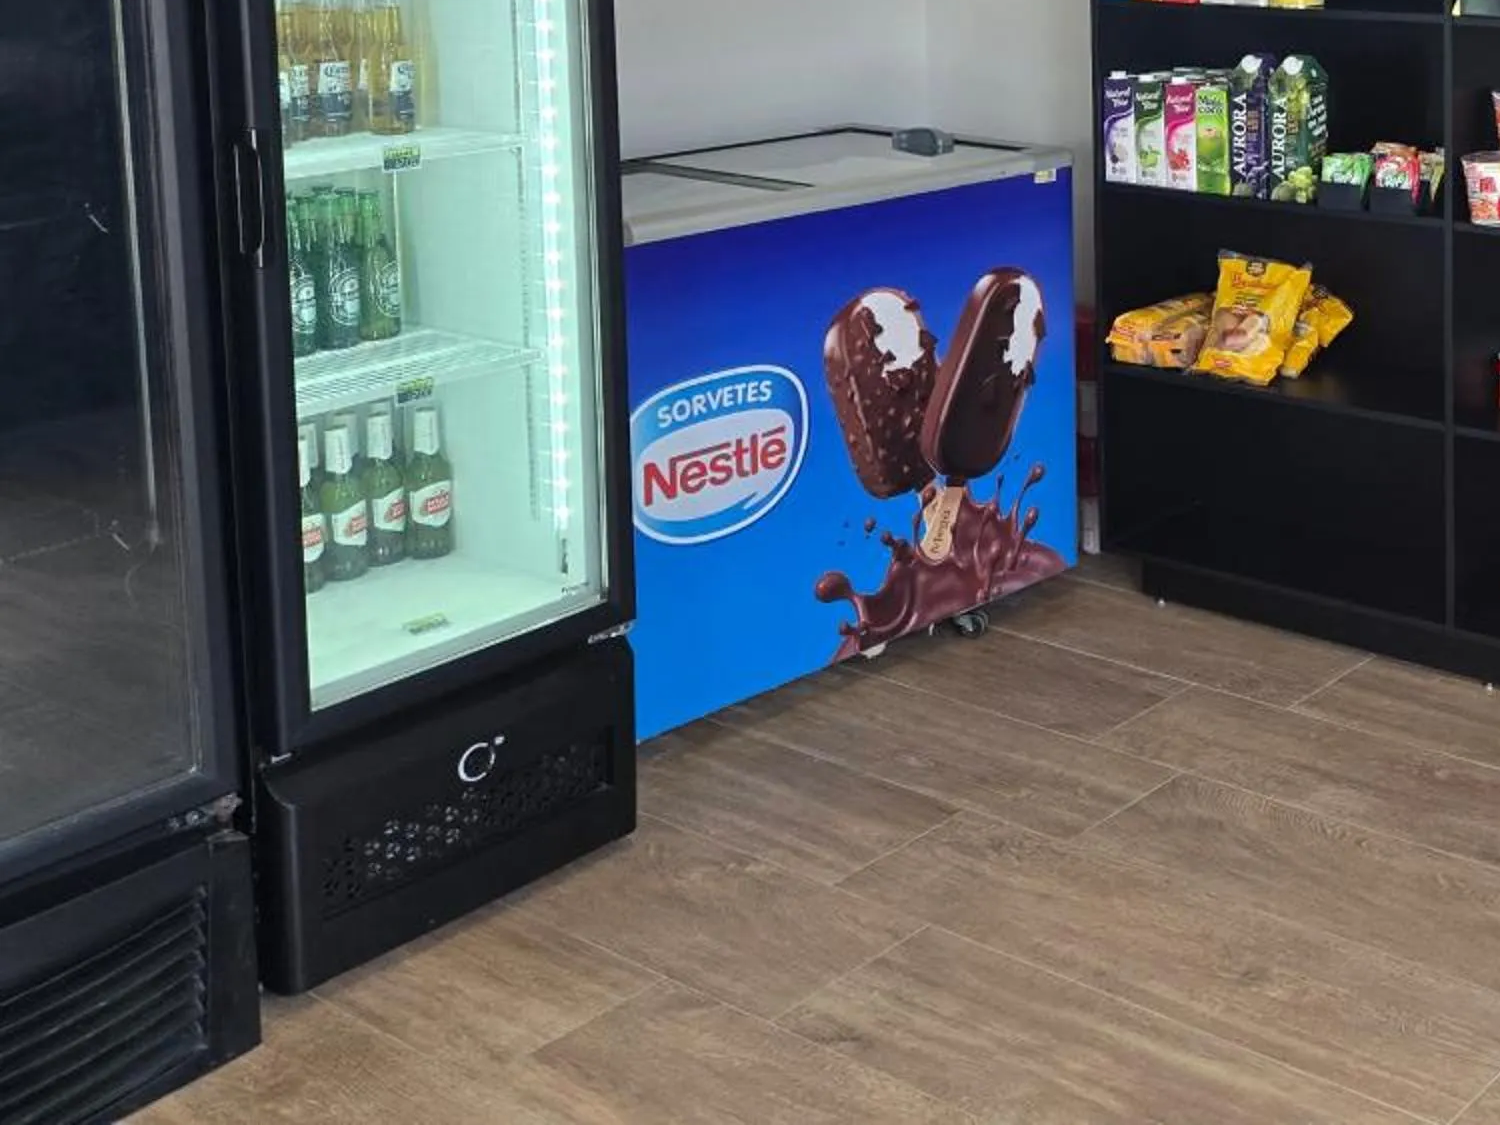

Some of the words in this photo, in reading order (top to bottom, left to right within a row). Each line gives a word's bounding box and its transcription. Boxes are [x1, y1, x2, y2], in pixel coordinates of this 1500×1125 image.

[1232, 92, 1248, 177] AURORA
[1271, 97, 1288, 180] AURORA
[656, 379, 773, 428] SORVETES
[642, 425, 788, 507] Nestlé
